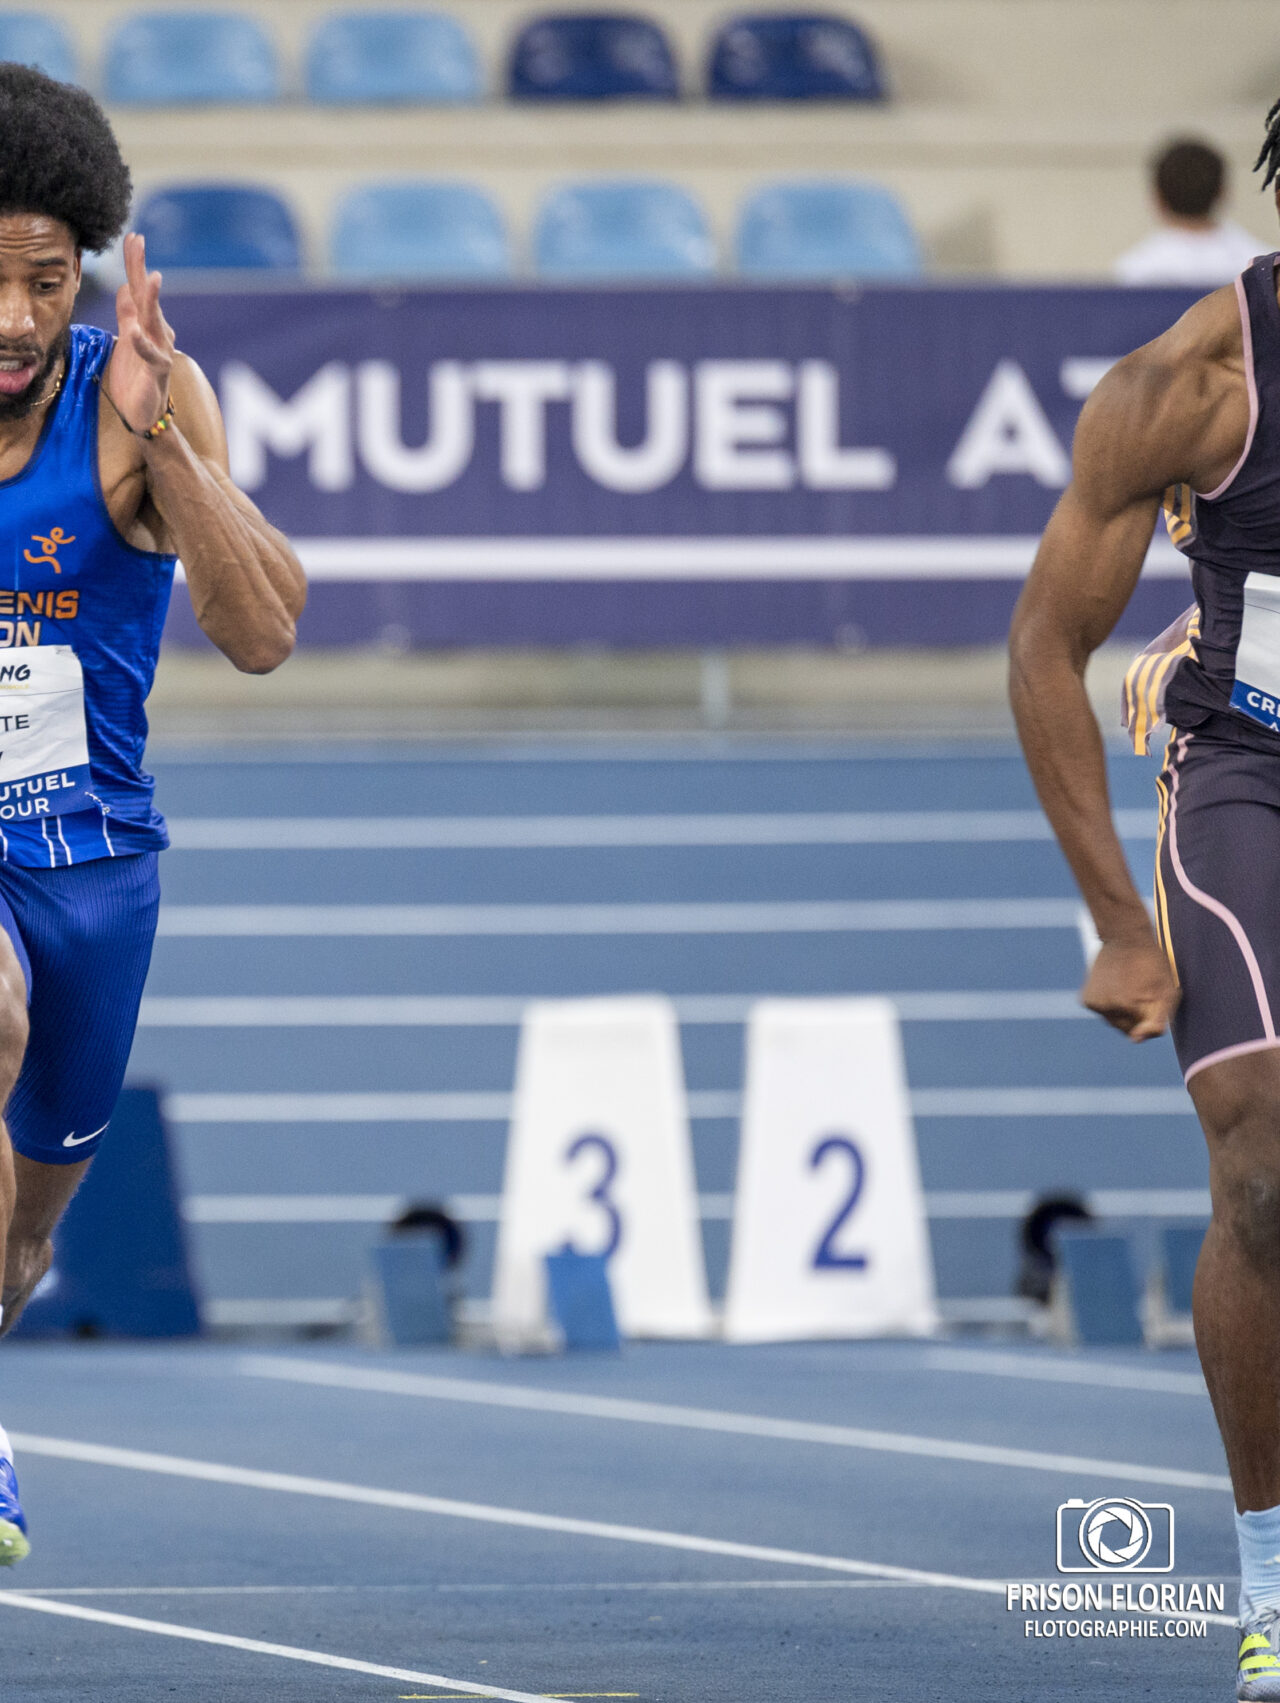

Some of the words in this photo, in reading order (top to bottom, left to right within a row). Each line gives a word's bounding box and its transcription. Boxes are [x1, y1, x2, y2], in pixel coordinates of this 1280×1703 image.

[222, 361, 895, 491] MUTUEL
[563, 1134, 623, 1258] 3
[809, 1135, 868, 1270] 2
